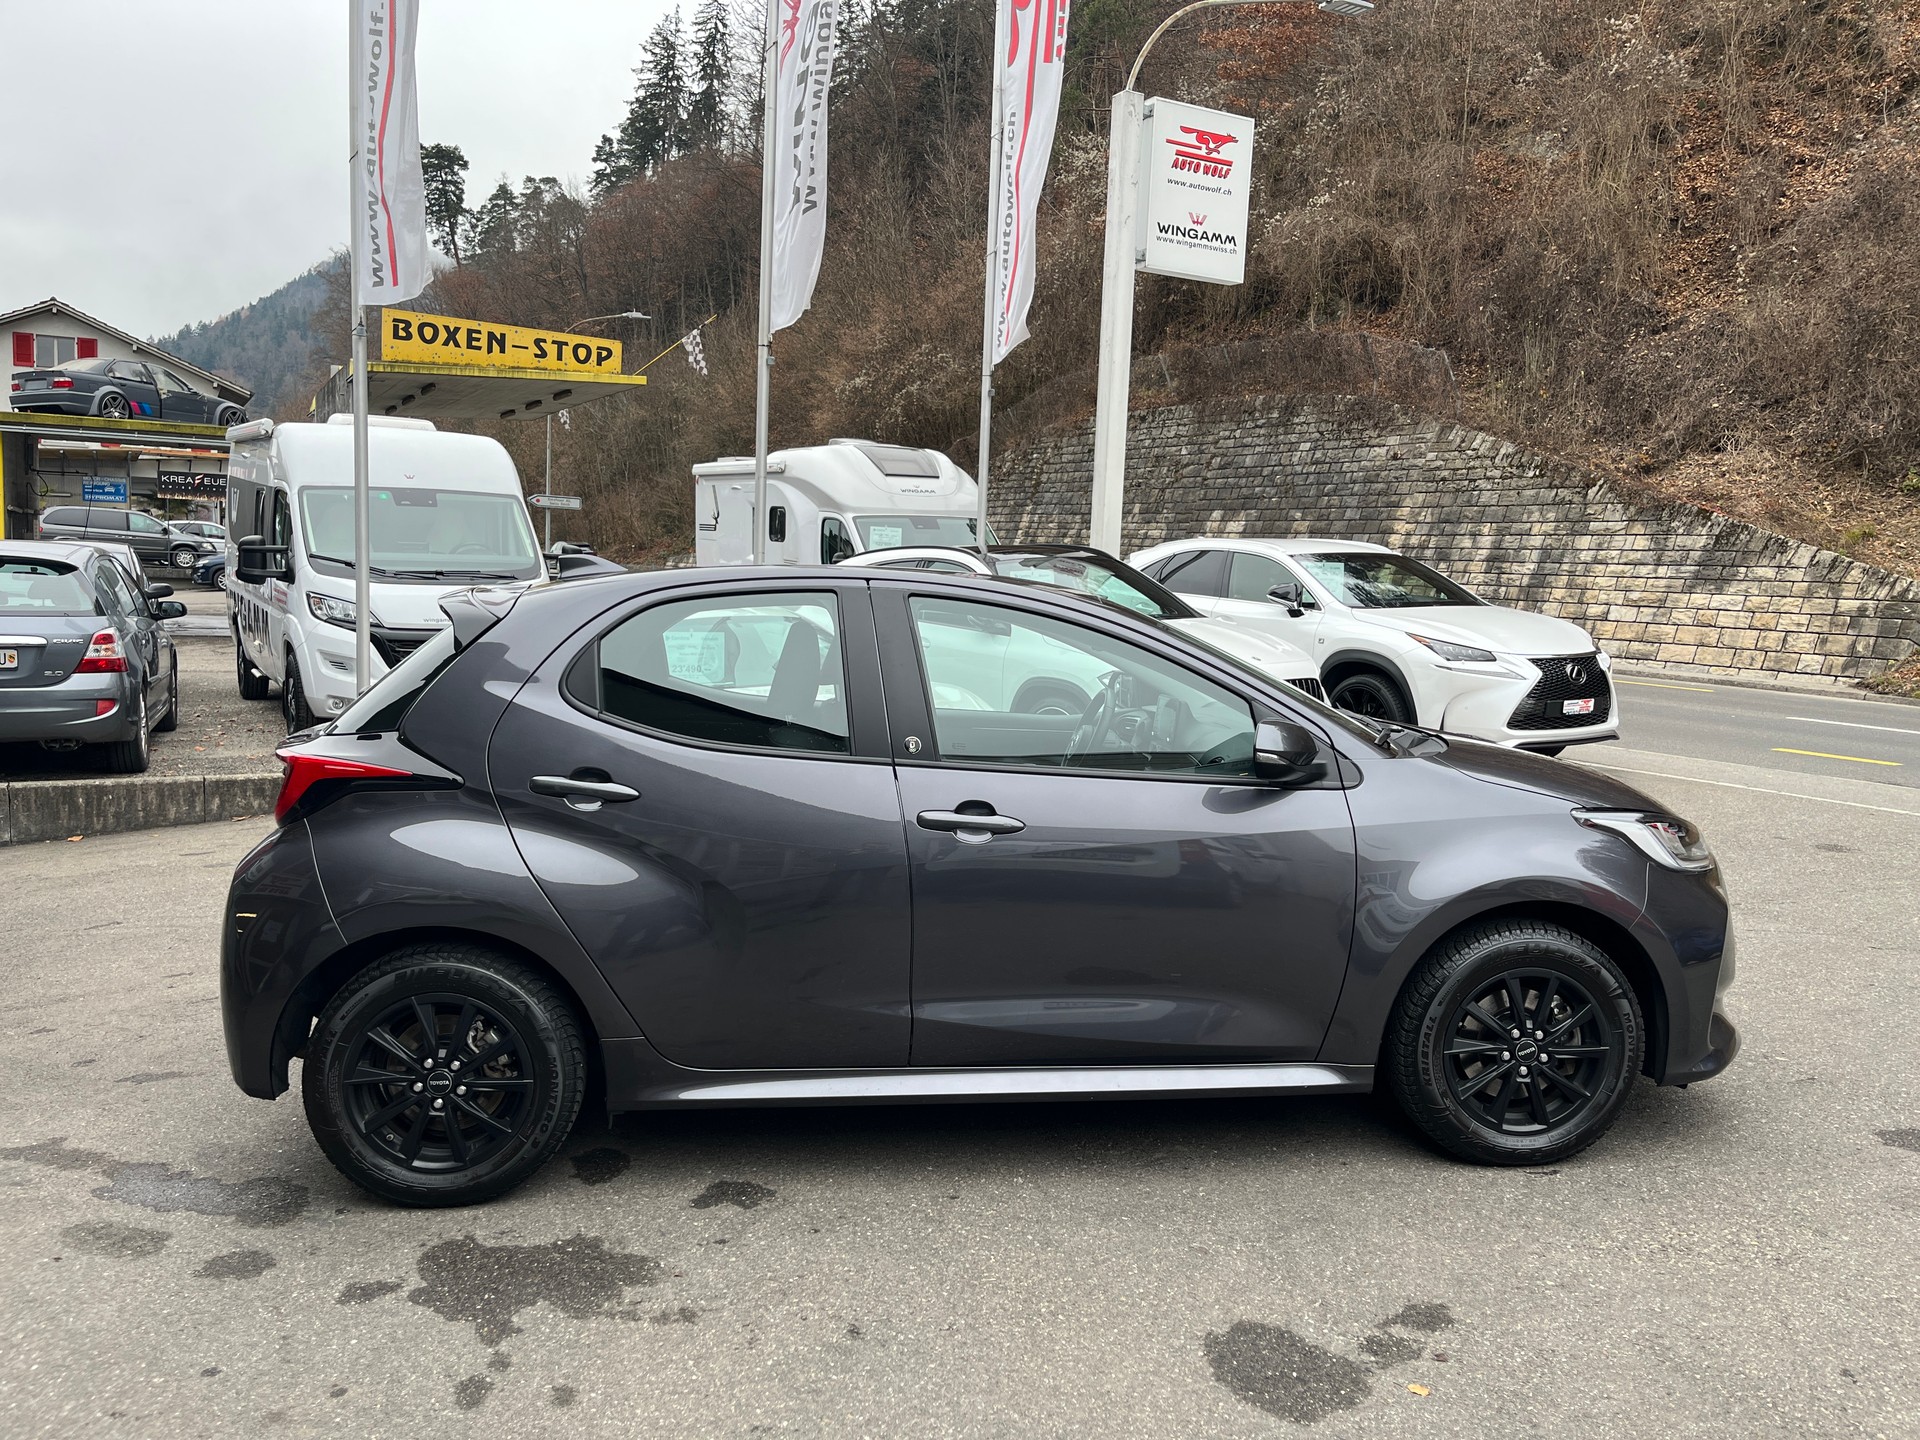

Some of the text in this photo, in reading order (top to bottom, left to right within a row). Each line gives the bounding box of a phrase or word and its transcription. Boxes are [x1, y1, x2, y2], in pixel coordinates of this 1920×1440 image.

[1171, 157, 1232, 180] AUTO WOLF
[1166, 178, 1232, 196] www.autowolf.ch
[1157, 221, 1237, 247] WINGAMM
[1156, 235, 1238, 255] www.wingammswiss.ch
